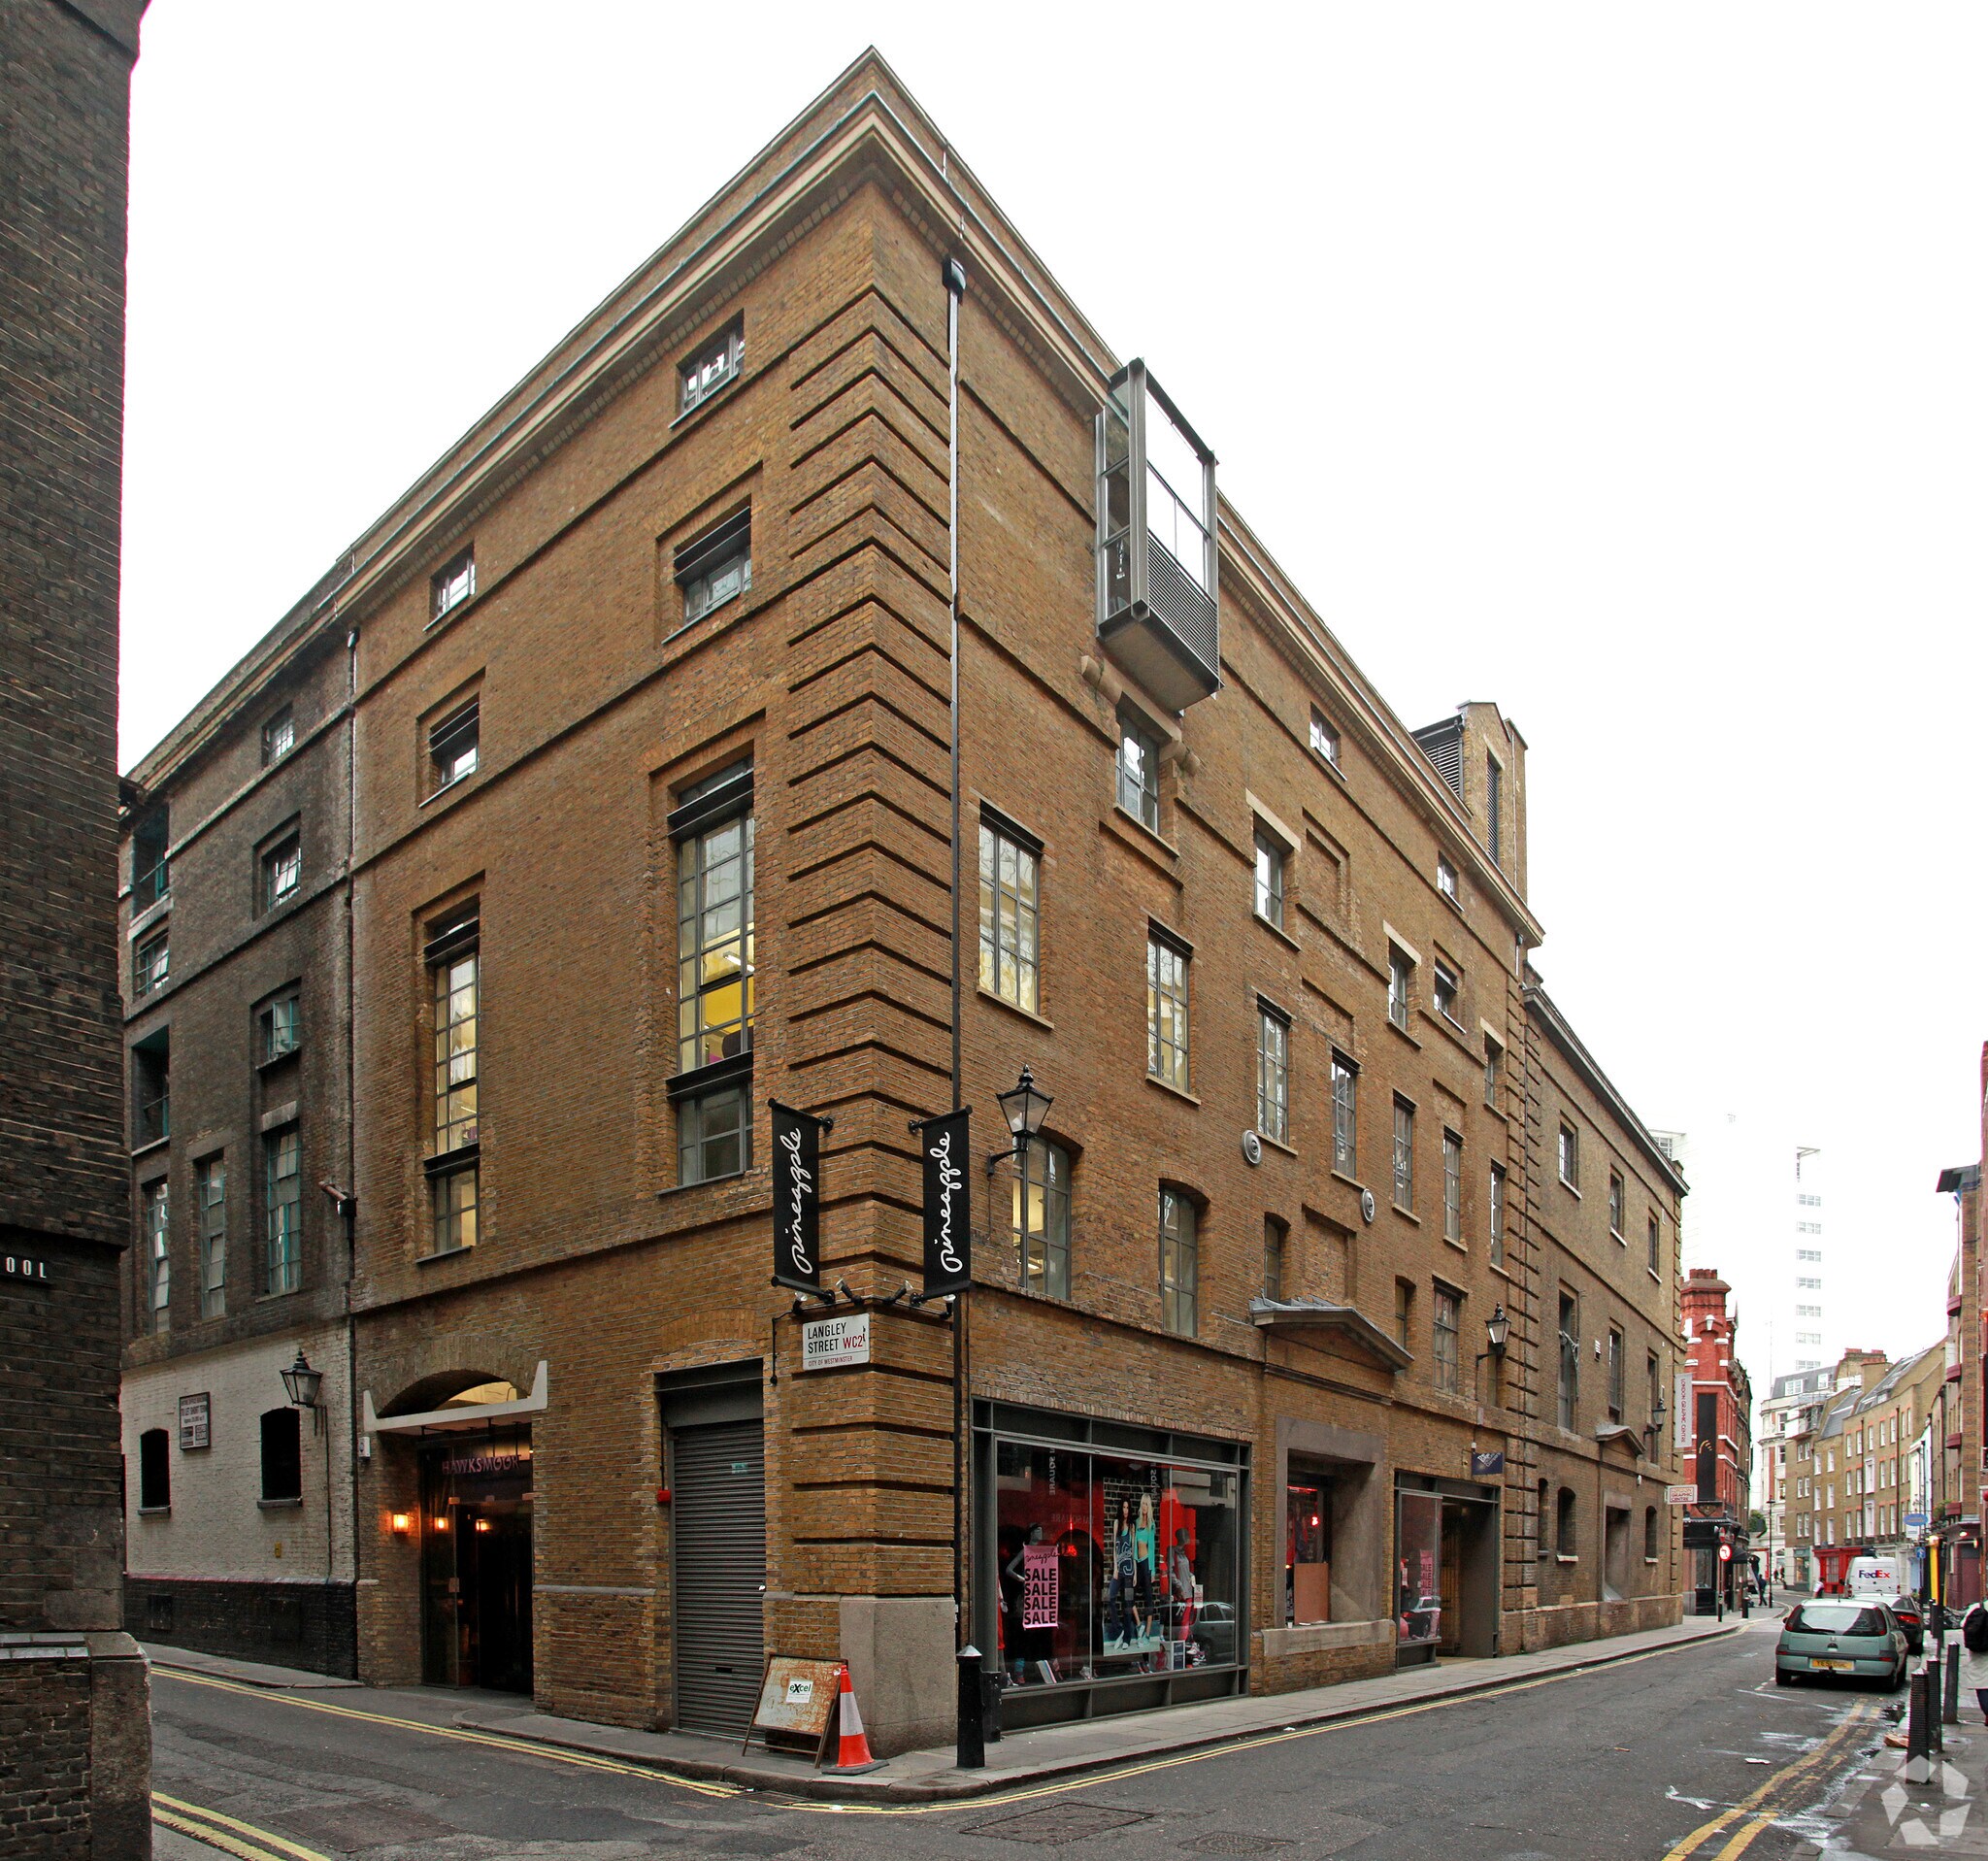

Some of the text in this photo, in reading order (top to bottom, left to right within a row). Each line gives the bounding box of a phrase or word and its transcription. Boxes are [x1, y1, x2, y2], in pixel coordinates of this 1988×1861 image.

[779, 1127, 813, 1275] pineapple
[929, 1131, 963, 1273] pineapple
[808, 1321, 846, 1340] LANGLEY
[808, 1338, 839, 1354] STREET
[824, 1355, 853, 1365] WESTMINSTER
[442, 1456, 519, 1475] HAWKSMOOR
[1024, 1568, 1057, 1581] SALE
[1858, 1569, 1890, 1579] FedEx
[1024, 1582, 1057, 1596] SALE
[1024, 1597, 1057, 1611] SALE
[1024, 1611, 1057, 1625] SALE
